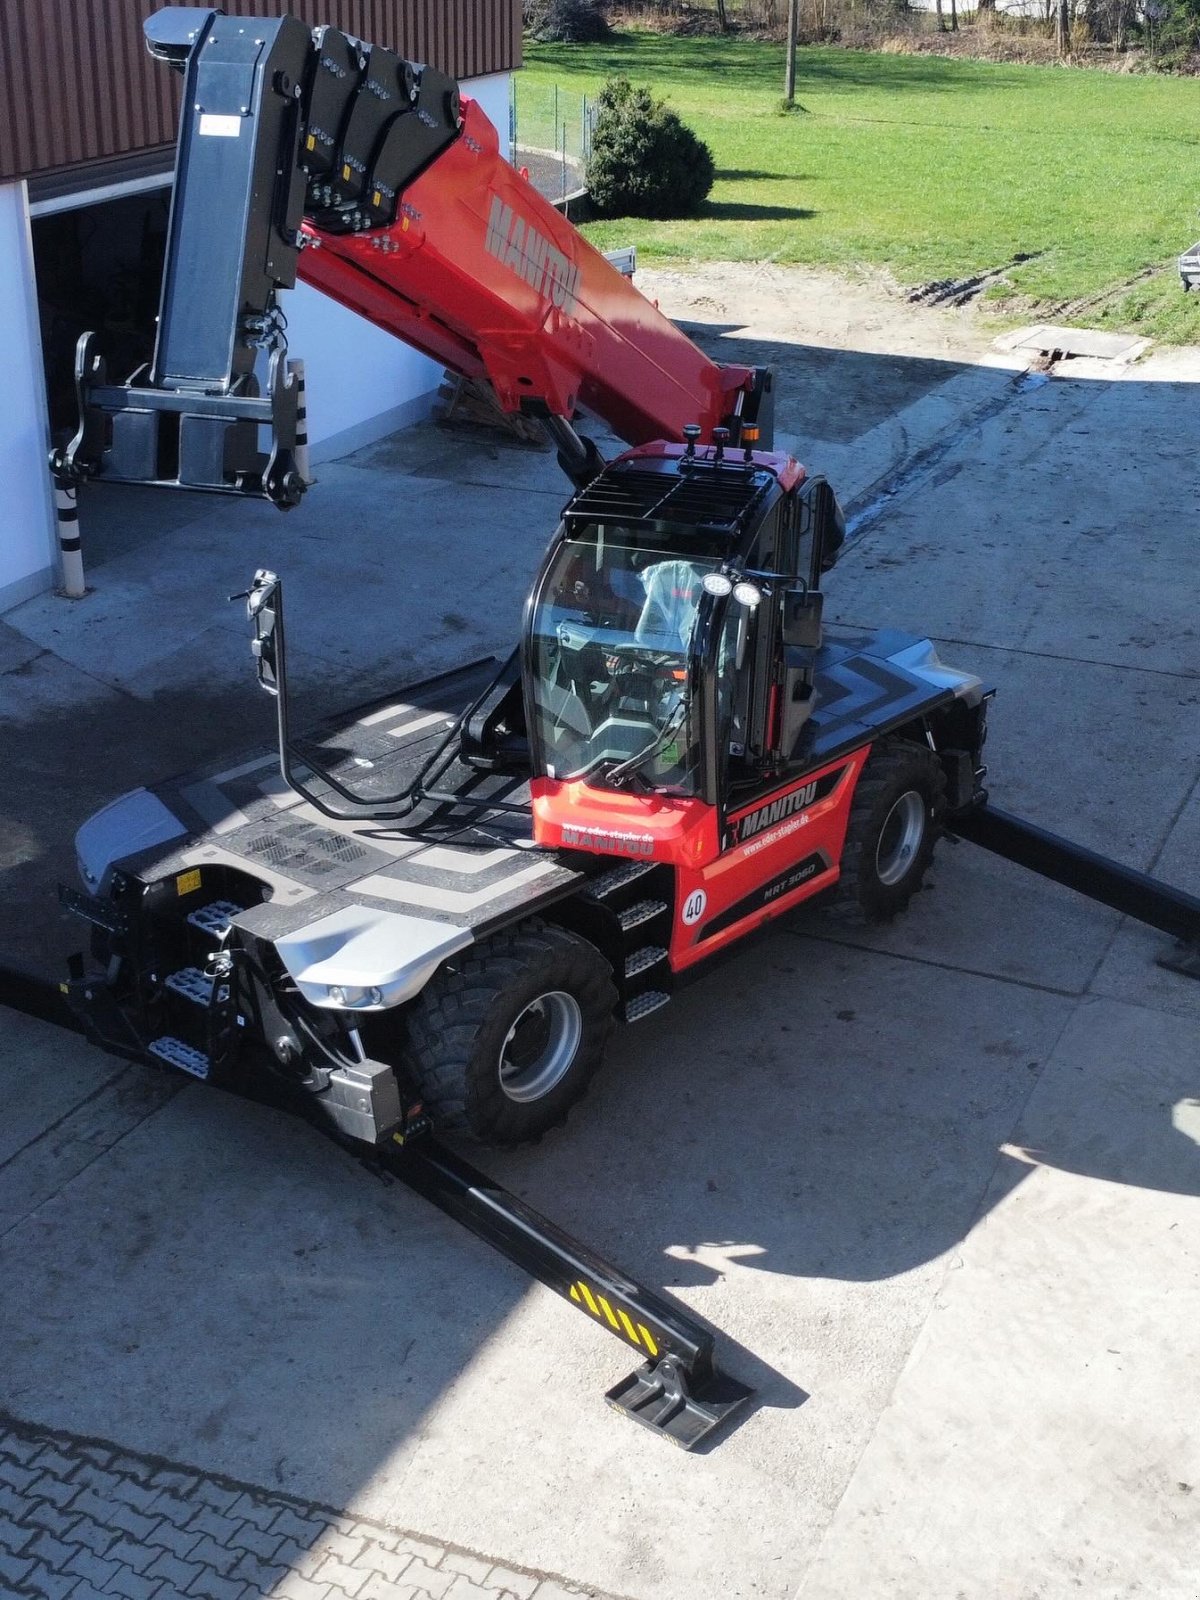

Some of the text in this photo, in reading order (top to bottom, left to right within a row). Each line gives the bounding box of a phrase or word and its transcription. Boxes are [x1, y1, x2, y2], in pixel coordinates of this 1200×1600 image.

[485, 195, 582, 316] MANITOU
[741, 781, 817, 838] MANITOU
[561, 829, 654, 855] MANITOU
[562, 823, 654, 842] www.eder-stapler.de
[743, 814, 809, 856] www.eder-stapler.de
[764, 880, 788, 900] MRT
[686, 894, 702, 919] 40
